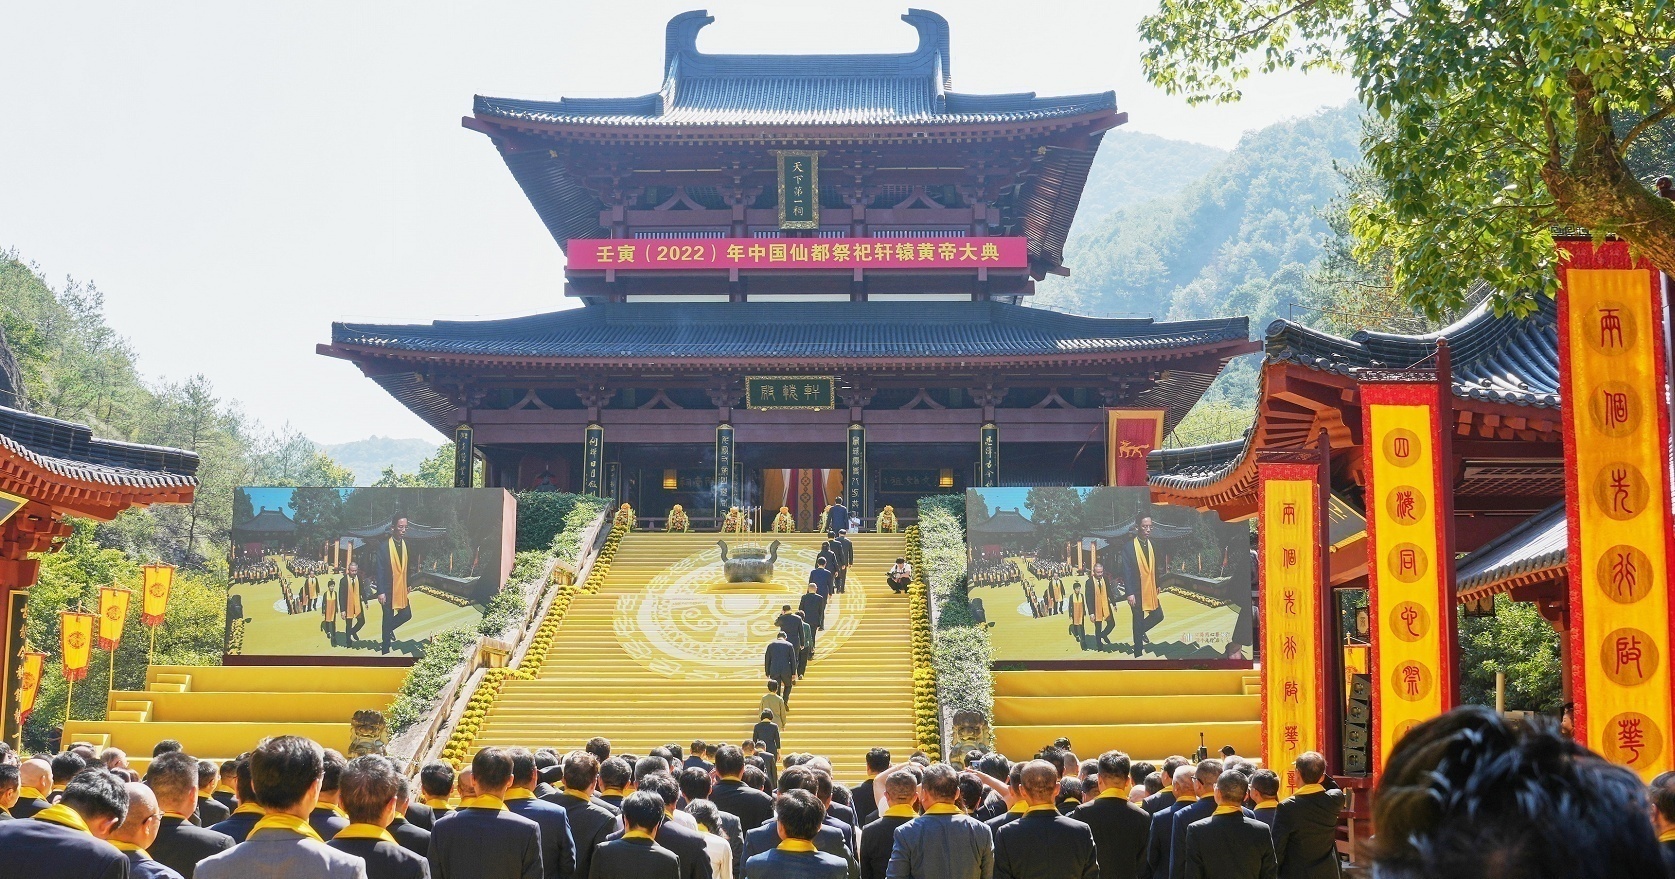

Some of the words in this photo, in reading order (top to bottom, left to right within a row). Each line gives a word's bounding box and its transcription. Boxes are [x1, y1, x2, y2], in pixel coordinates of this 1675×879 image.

[791, 161, 805, 217] 天下第一祠
[596, 242, 1000, 264] 壬寅（2022）年中国仙都祭祀轩辕黄帝大典
[1393, 437, 1422, 738] 四海同心祭
